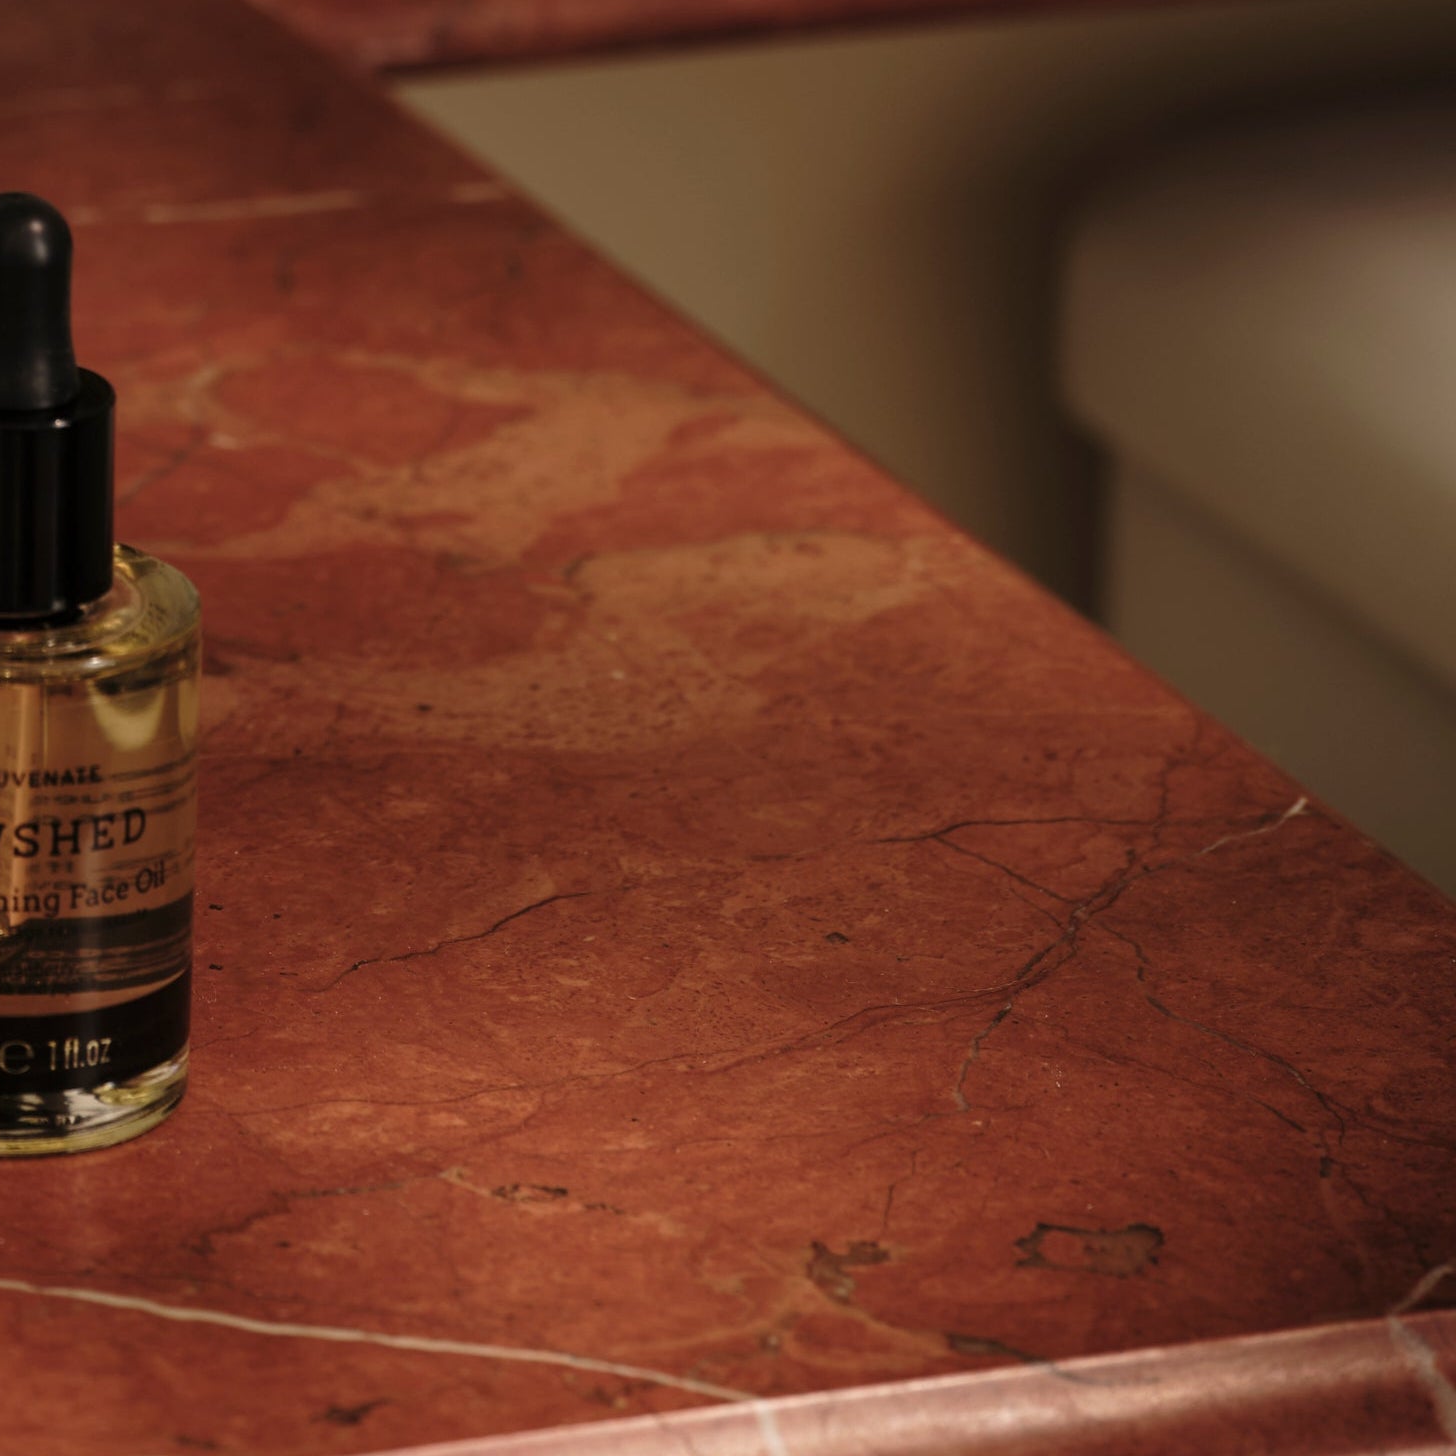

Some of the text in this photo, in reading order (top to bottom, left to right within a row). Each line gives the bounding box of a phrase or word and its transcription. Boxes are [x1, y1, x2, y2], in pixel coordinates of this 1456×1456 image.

[69, 881, 128, 909] Face
[135, 864, 166, 894] Oil
[48, 1041, 56, 1068] 1
[63, 1038, 111, 1068] fl.oz
